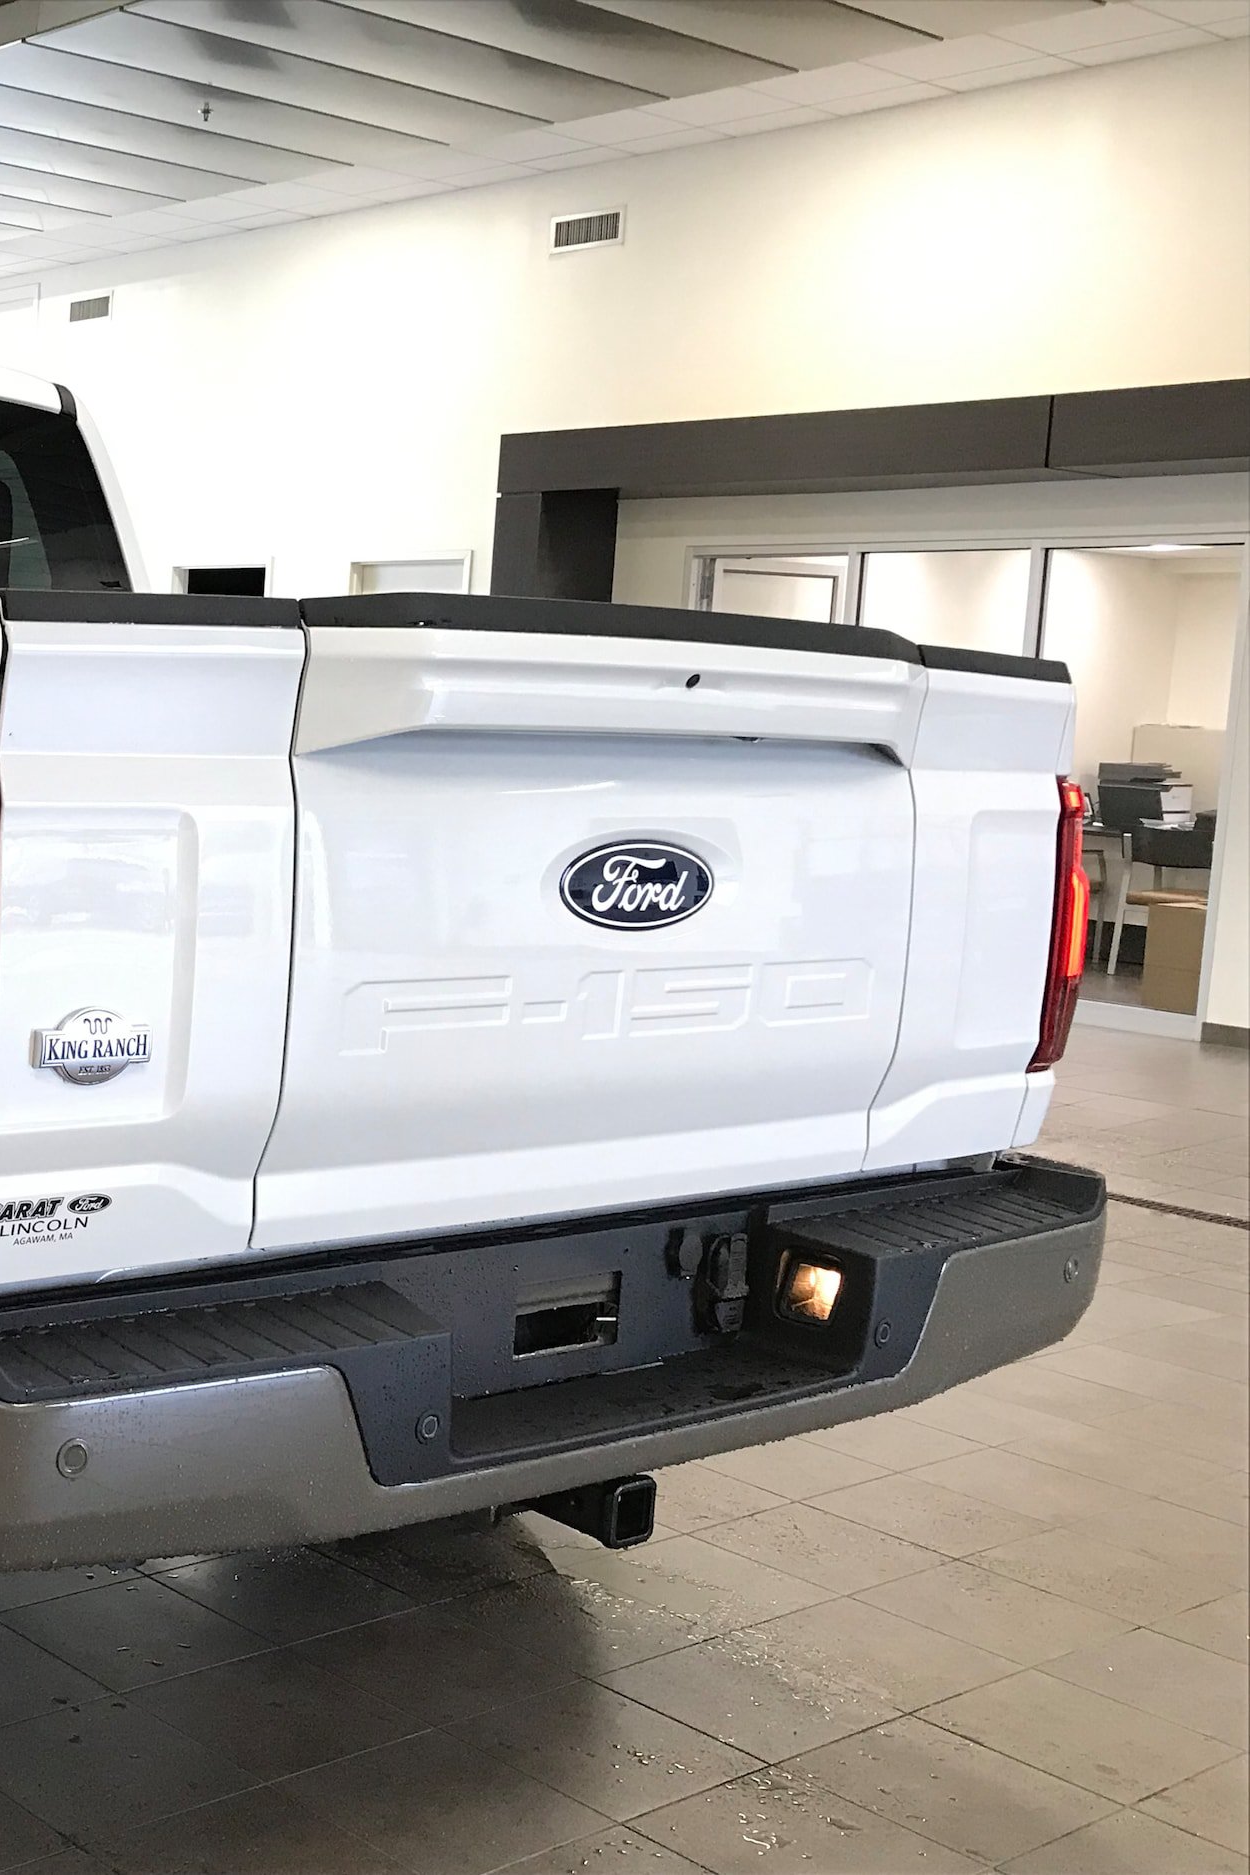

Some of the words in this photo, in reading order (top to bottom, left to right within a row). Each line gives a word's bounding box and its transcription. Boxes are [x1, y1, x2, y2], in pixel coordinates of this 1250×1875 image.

[591, 855, 689, 912] Ford
[338, 957, 876, 1056] F-150
[47, 1038, 88, 1061] KING
[92, 1033, 148, 1058] RANCH
[0, 1216, 89, 1238] LINCOLN
[12, 1234, 57, 1246] AGAWAM,
[59, 1232, 73, 1241] MA
